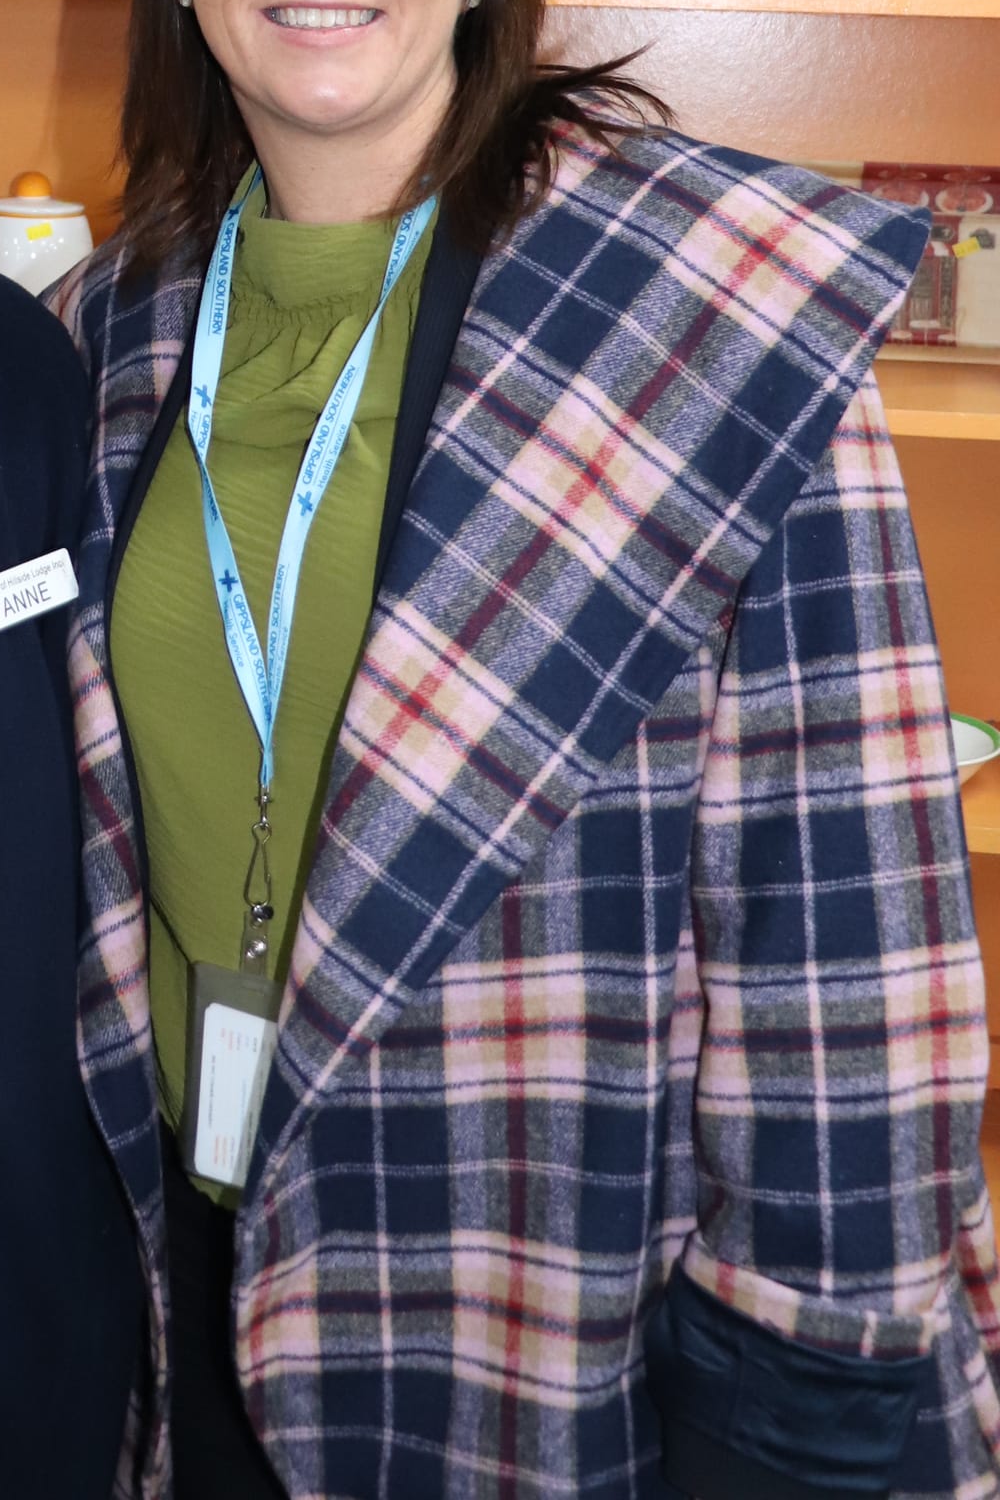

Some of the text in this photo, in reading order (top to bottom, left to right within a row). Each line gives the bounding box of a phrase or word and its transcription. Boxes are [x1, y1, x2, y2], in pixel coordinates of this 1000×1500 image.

[211, 279, 228, 336] SOUTHERN
[302, 364, 356, 485] GIPPSLAND SOUTHERN
[317, 422, 347, 489] Health Service
[3, 580, 52, 618] ANNE
[233, 593, 260, 657] GIPPSLAND
